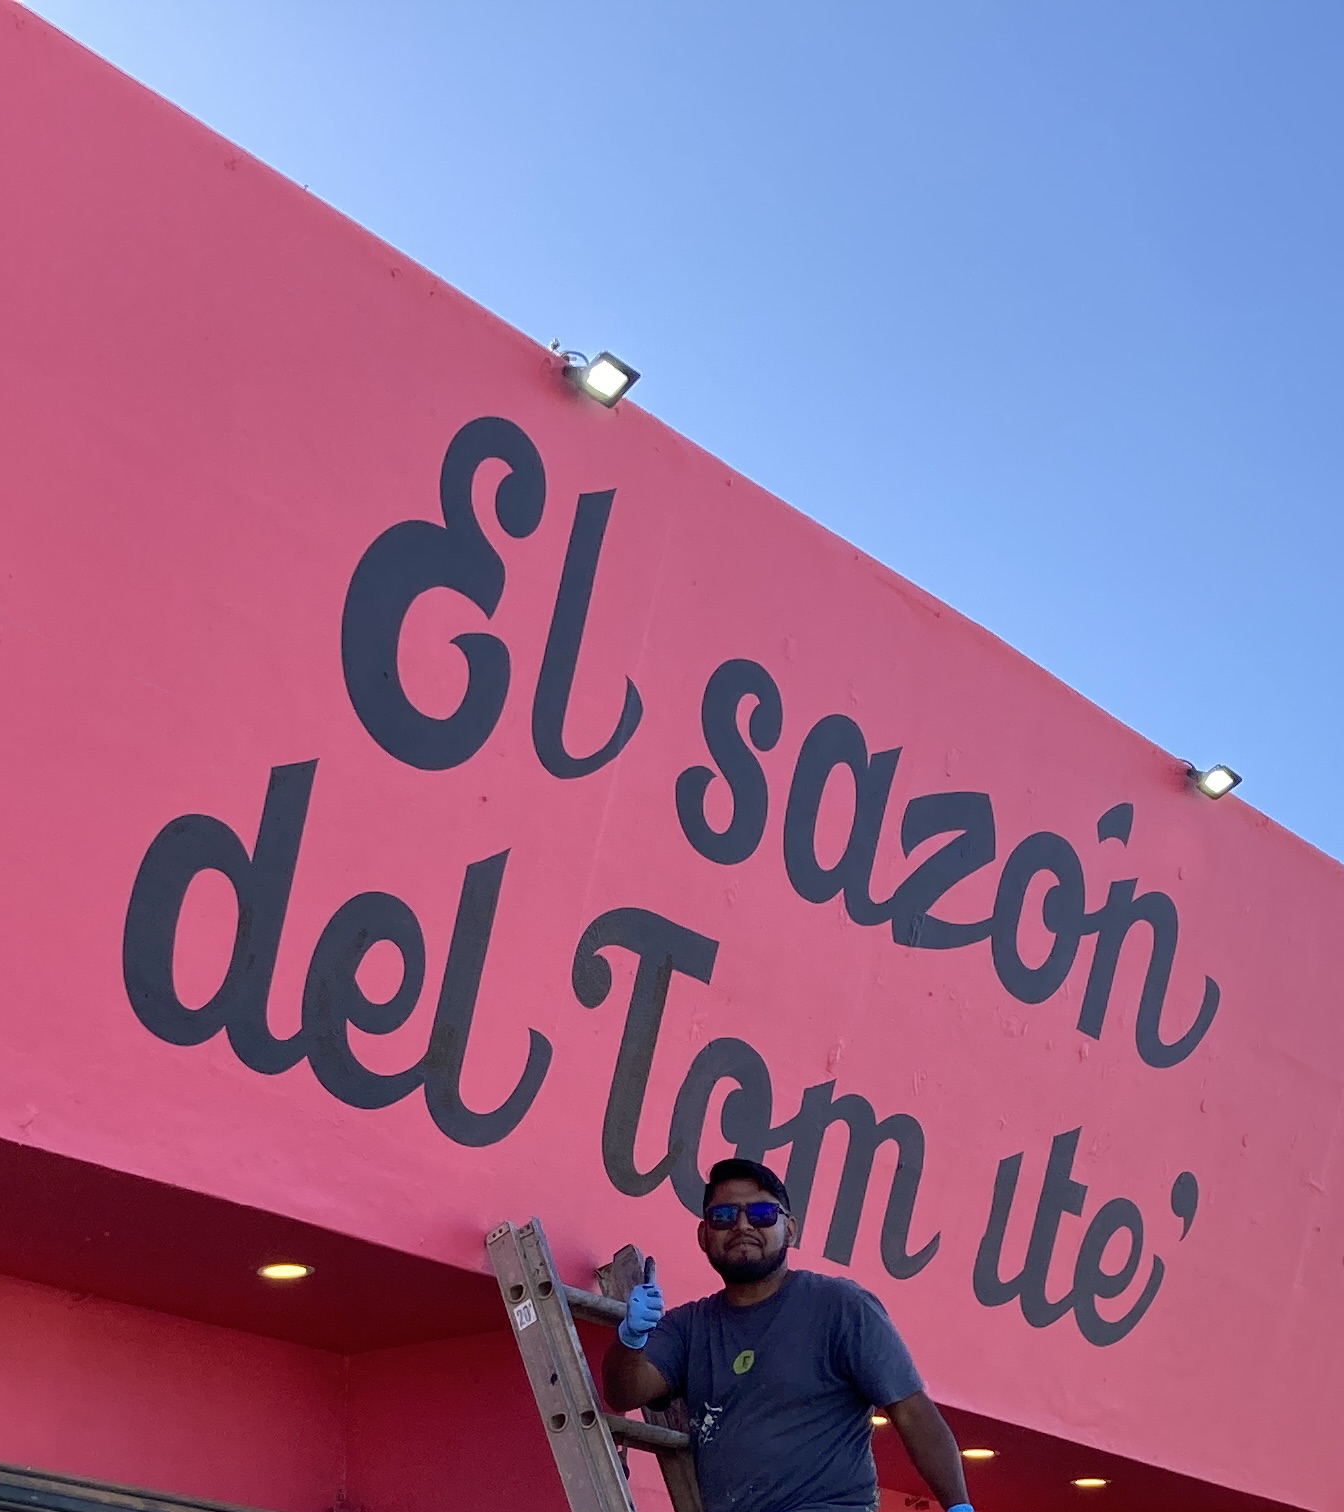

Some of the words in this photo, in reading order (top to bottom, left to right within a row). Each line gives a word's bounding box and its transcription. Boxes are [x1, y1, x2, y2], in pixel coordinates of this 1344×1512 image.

[122, 757, 553, 1148] del
[341, 416, 644, 780] El
[675, 658, 1221, 1070] sazón
